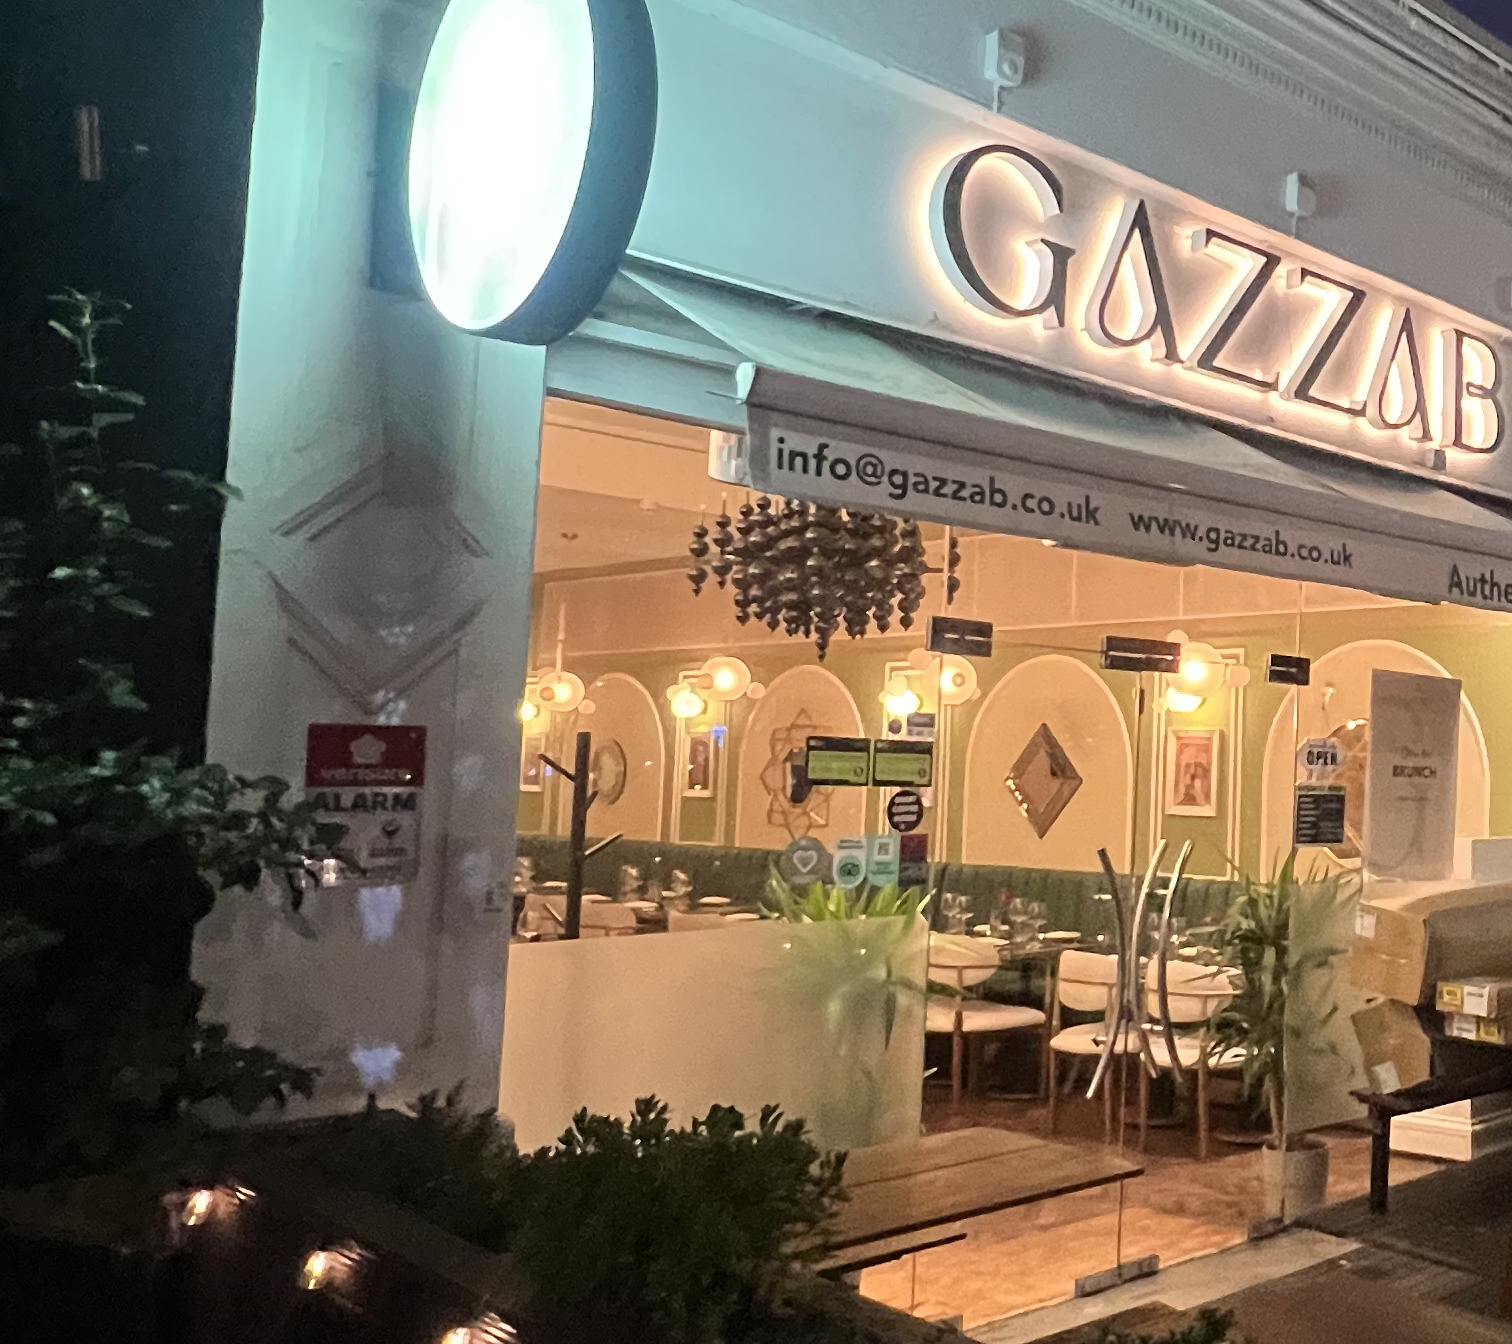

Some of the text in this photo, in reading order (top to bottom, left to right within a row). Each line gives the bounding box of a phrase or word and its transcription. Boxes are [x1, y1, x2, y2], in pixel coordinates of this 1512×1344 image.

[930, 143, 1504, 455] GAZZAB
[774, 436, 1354, 570] info@gazzab.co.uk www.gazzab.co.uk
[1306, 750, 1338, 765] OPEN
[1392, 765, 1438, 778] BRUNCH
[312, 791, 417, 812] ALARM
